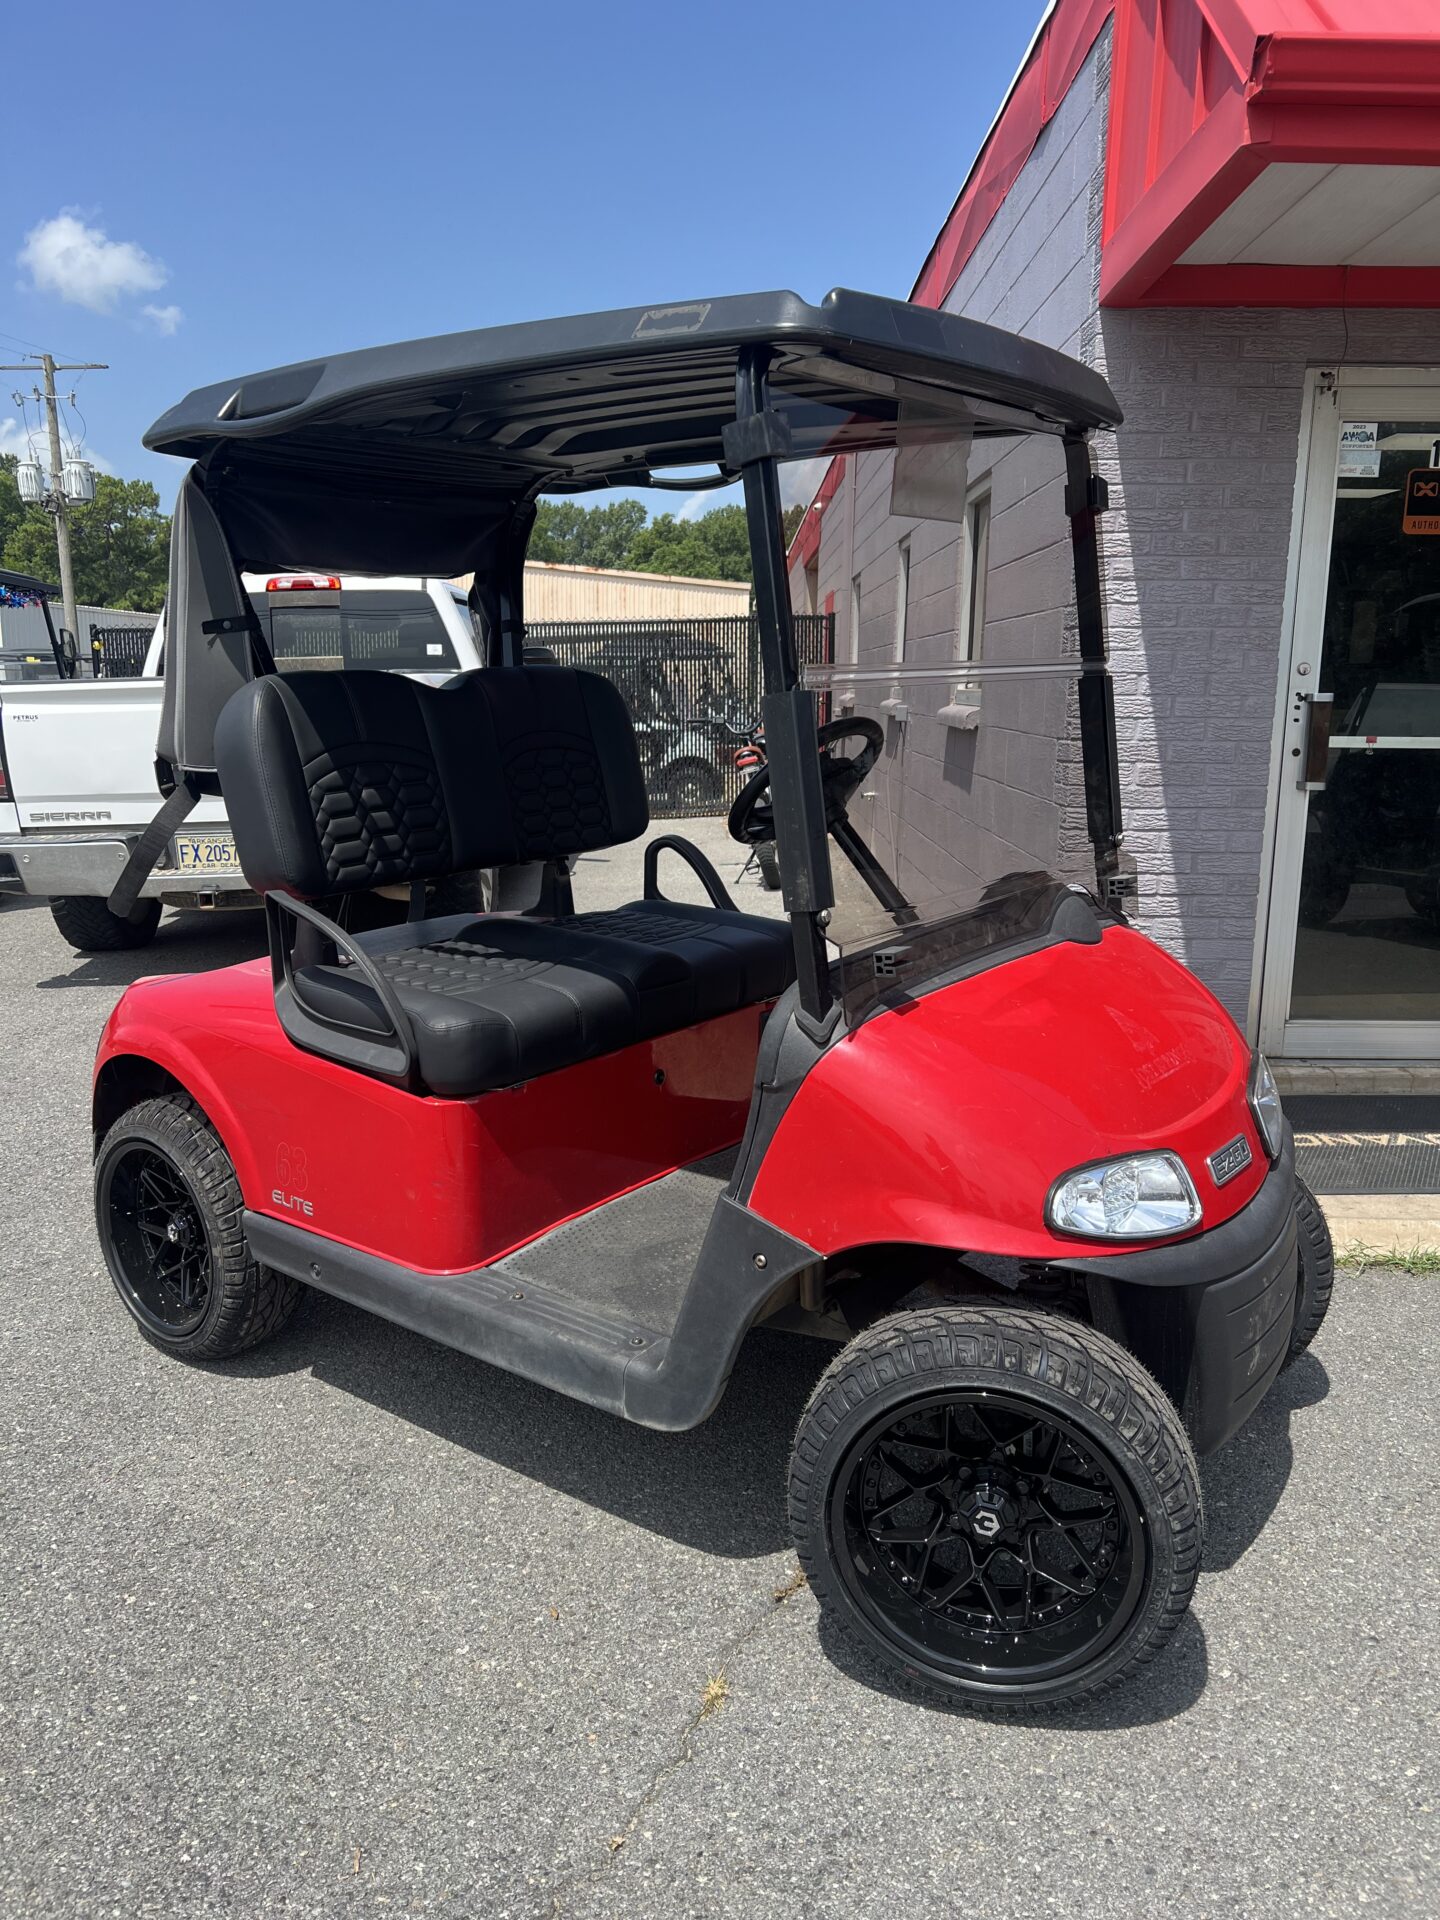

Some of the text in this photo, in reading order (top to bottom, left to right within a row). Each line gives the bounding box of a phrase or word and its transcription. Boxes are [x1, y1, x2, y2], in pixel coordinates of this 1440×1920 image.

[29, 811, 112, 822] SIERRA
[179, 844, 238, 863] FX 2057
[275, 1142, 309, 1192] 63
[271, 1189, 314, 1216] ELITE
